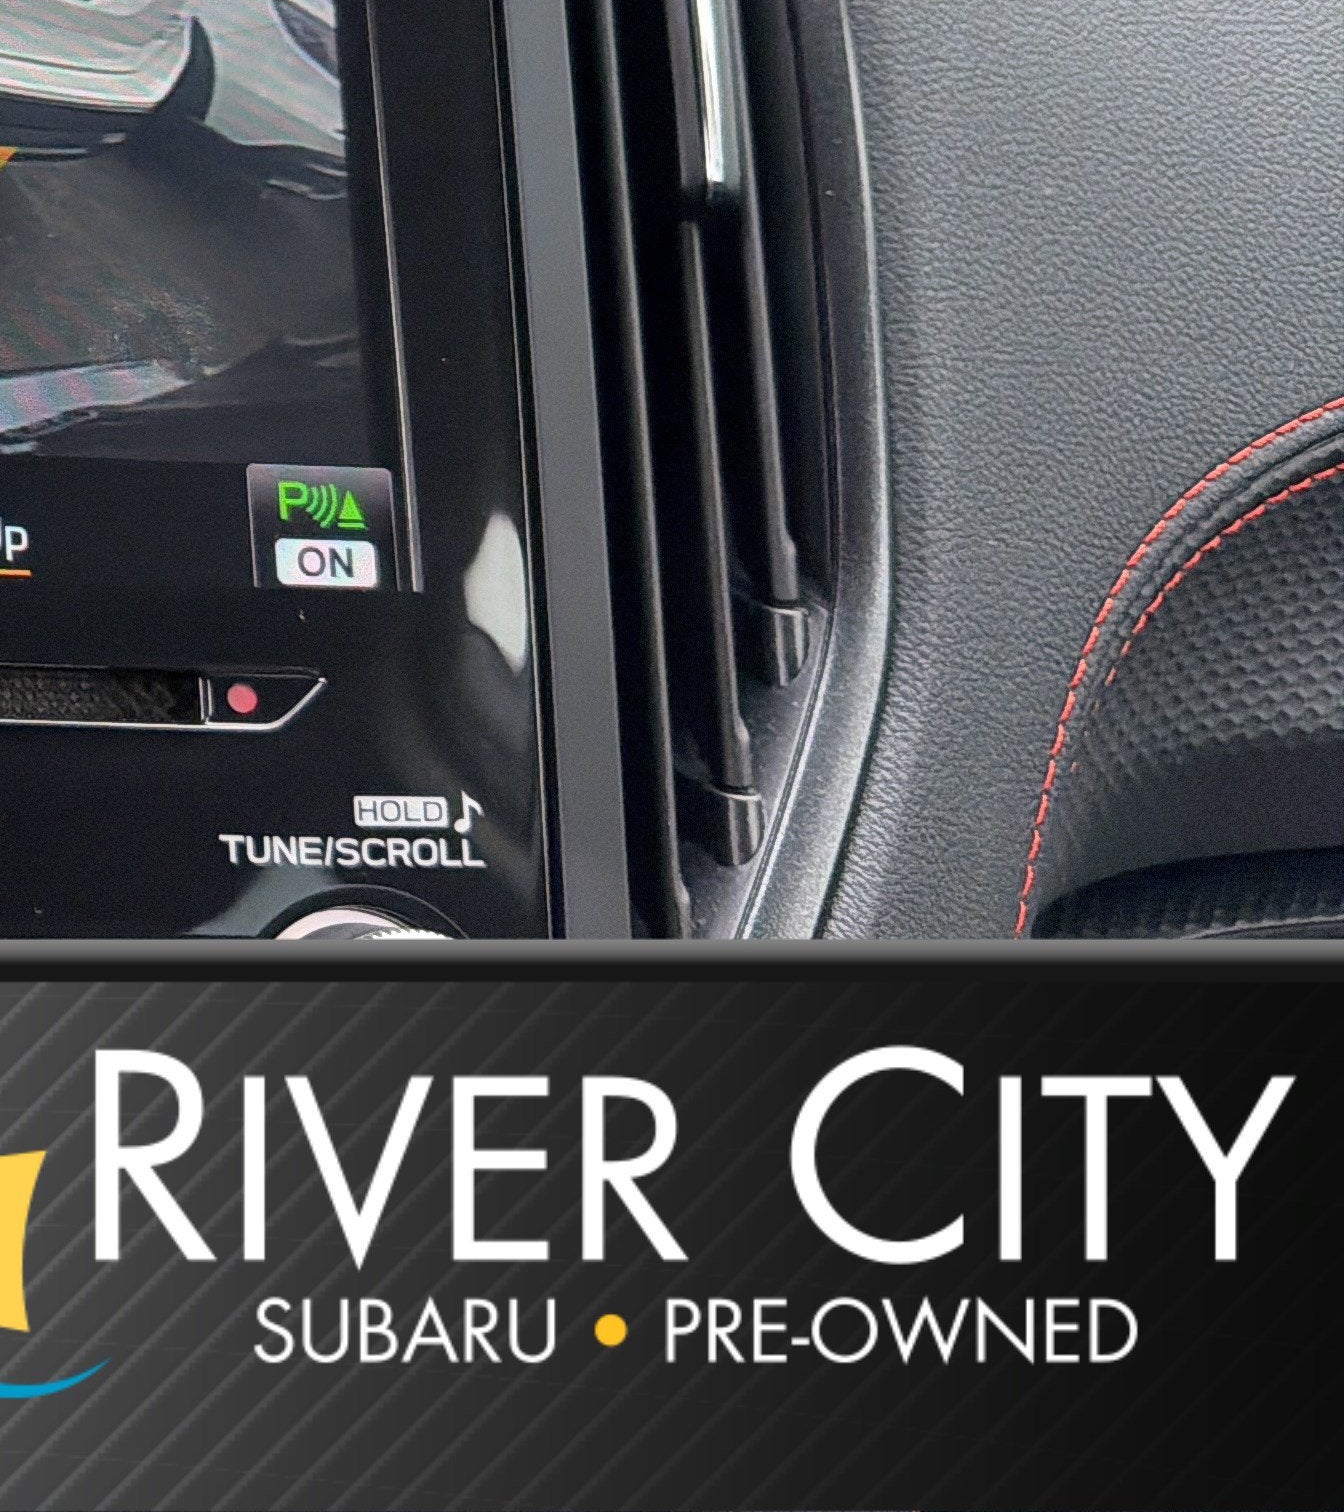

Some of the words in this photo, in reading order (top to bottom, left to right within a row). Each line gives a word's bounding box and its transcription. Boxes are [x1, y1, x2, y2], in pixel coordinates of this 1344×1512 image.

[278, 480, 309, 521] P
[297, 546, 354, 578] ON
[359, 798, 443, 823] HOLD
[218, 834, 487, 867] TUNE/SCROLL
